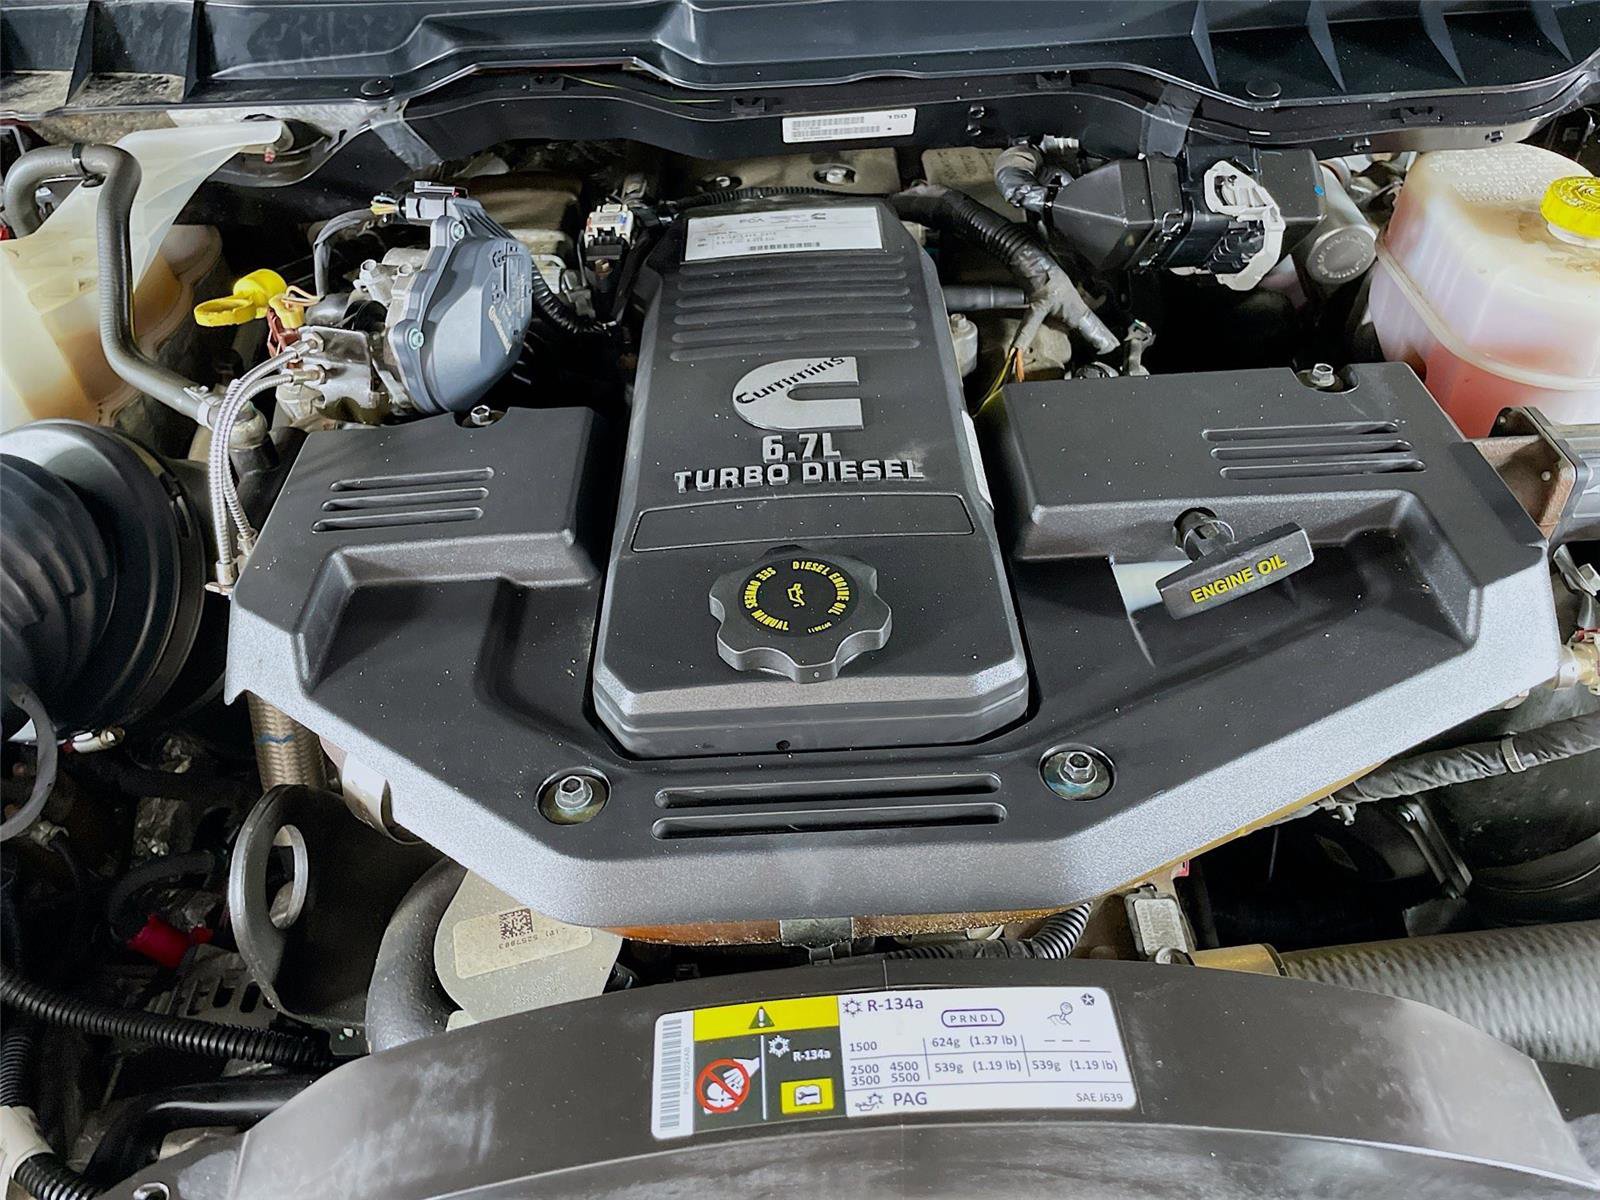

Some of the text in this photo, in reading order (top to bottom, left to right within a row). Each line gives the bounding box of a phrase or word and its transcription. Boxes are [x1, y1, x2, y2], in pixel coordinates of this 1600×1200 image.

[735, 357, 845, 404] Cummins
[762, 432, 841, 463] 6.7L
[674, 459, 926, 493] TURBO DIESEL
[756, 567, 777, 581] SEE
[1191, 554, 1288, 603] ENGINE OIL
[792, 561, 850, 615] DIESEL ENGINE OIL
[751, 609, 789, 631] MANUAL
[866, 997, 924, 1013] R-134a
[849, 1034, 1018, 1052] 1500 624g (1.37 lb)
[793, 1049, 832, 1062] R-134a
[850, 1059, 1118, 1076] 2500 4500 539g (1.19 lb) 539g (1.19 lb)
[851, 1072, 920, 1086] 3500 5500
[893, 1091, 1124, 1106] PAG SAE J639
